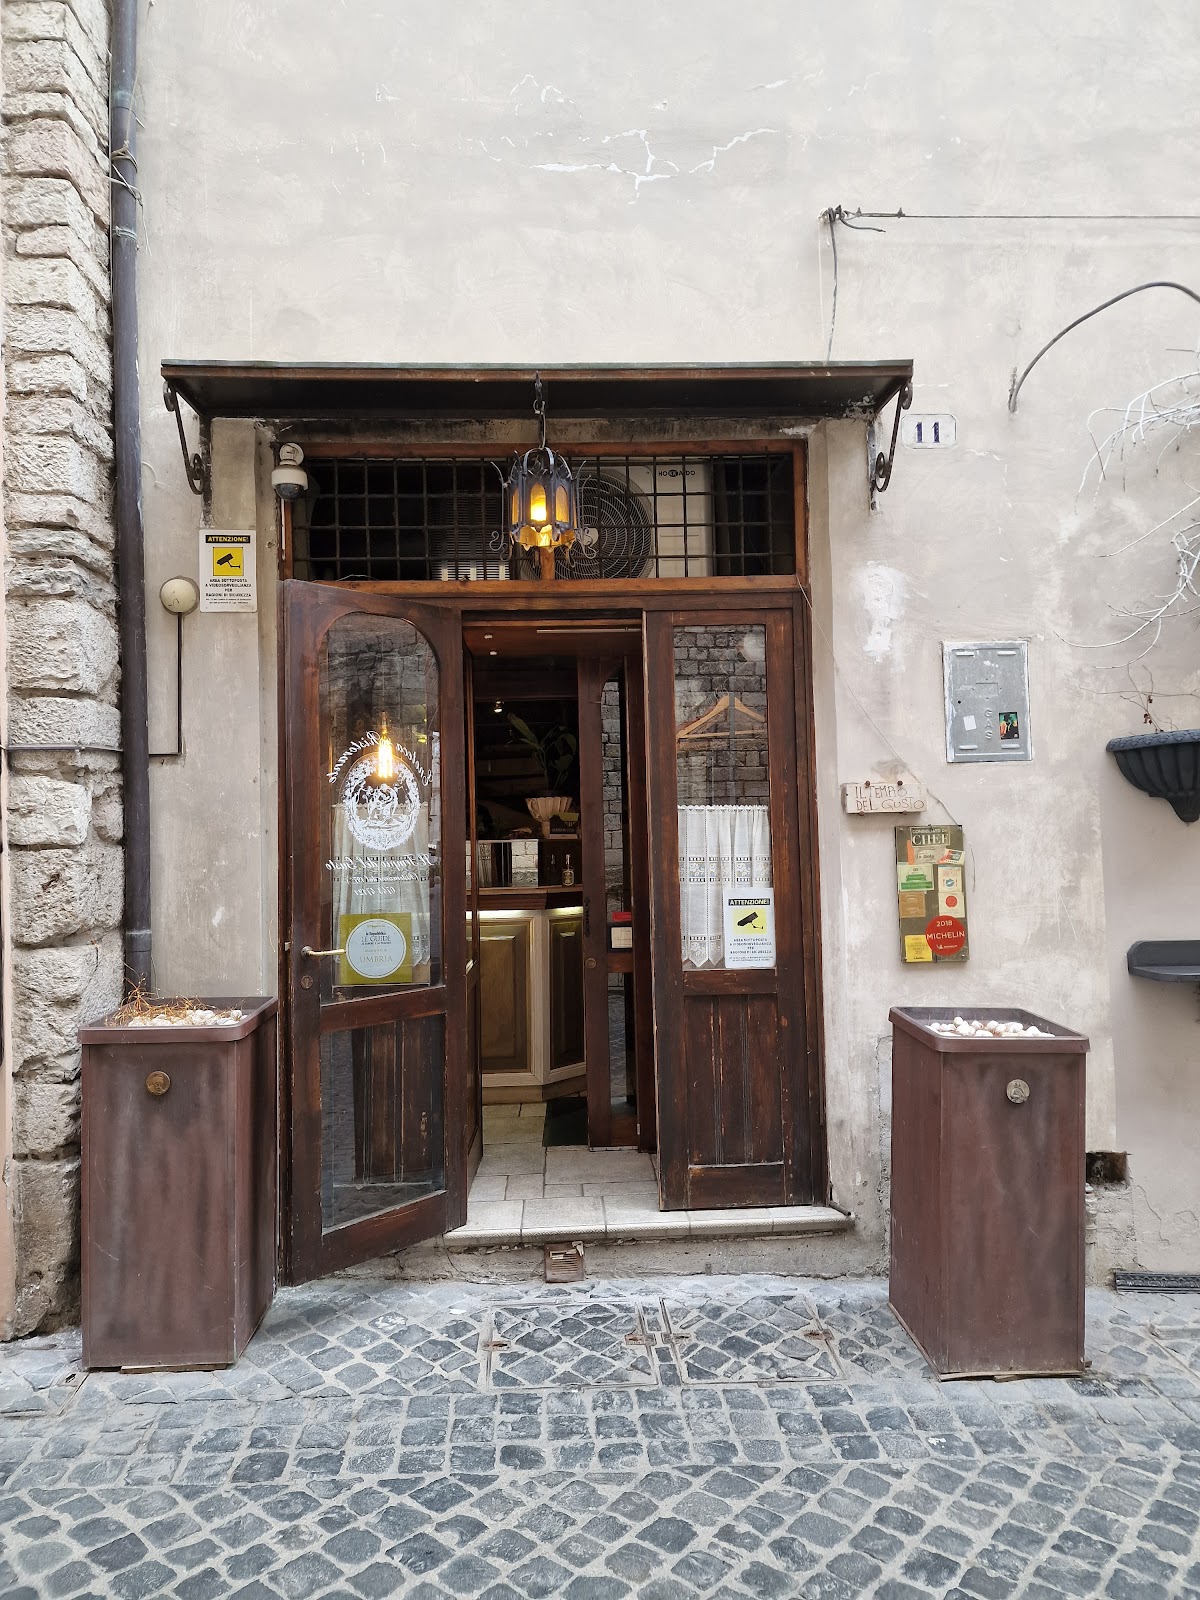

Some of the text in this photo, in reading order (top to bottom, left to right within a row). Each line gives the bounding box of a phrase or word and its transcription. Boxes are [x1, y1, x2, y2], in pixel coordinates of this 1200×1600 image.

[915, 422, 940, 443] 11
[658, 469, 696, 477] HOKKADO
[855, 786, 867, 799] IL
[856, 797, 925, 811] DEL GUSTO
[912, 833, 949, 846] CHEF
[926, 931, 965, 941] MICHELIN
[359, 955, 393, 964] UMBRIA
